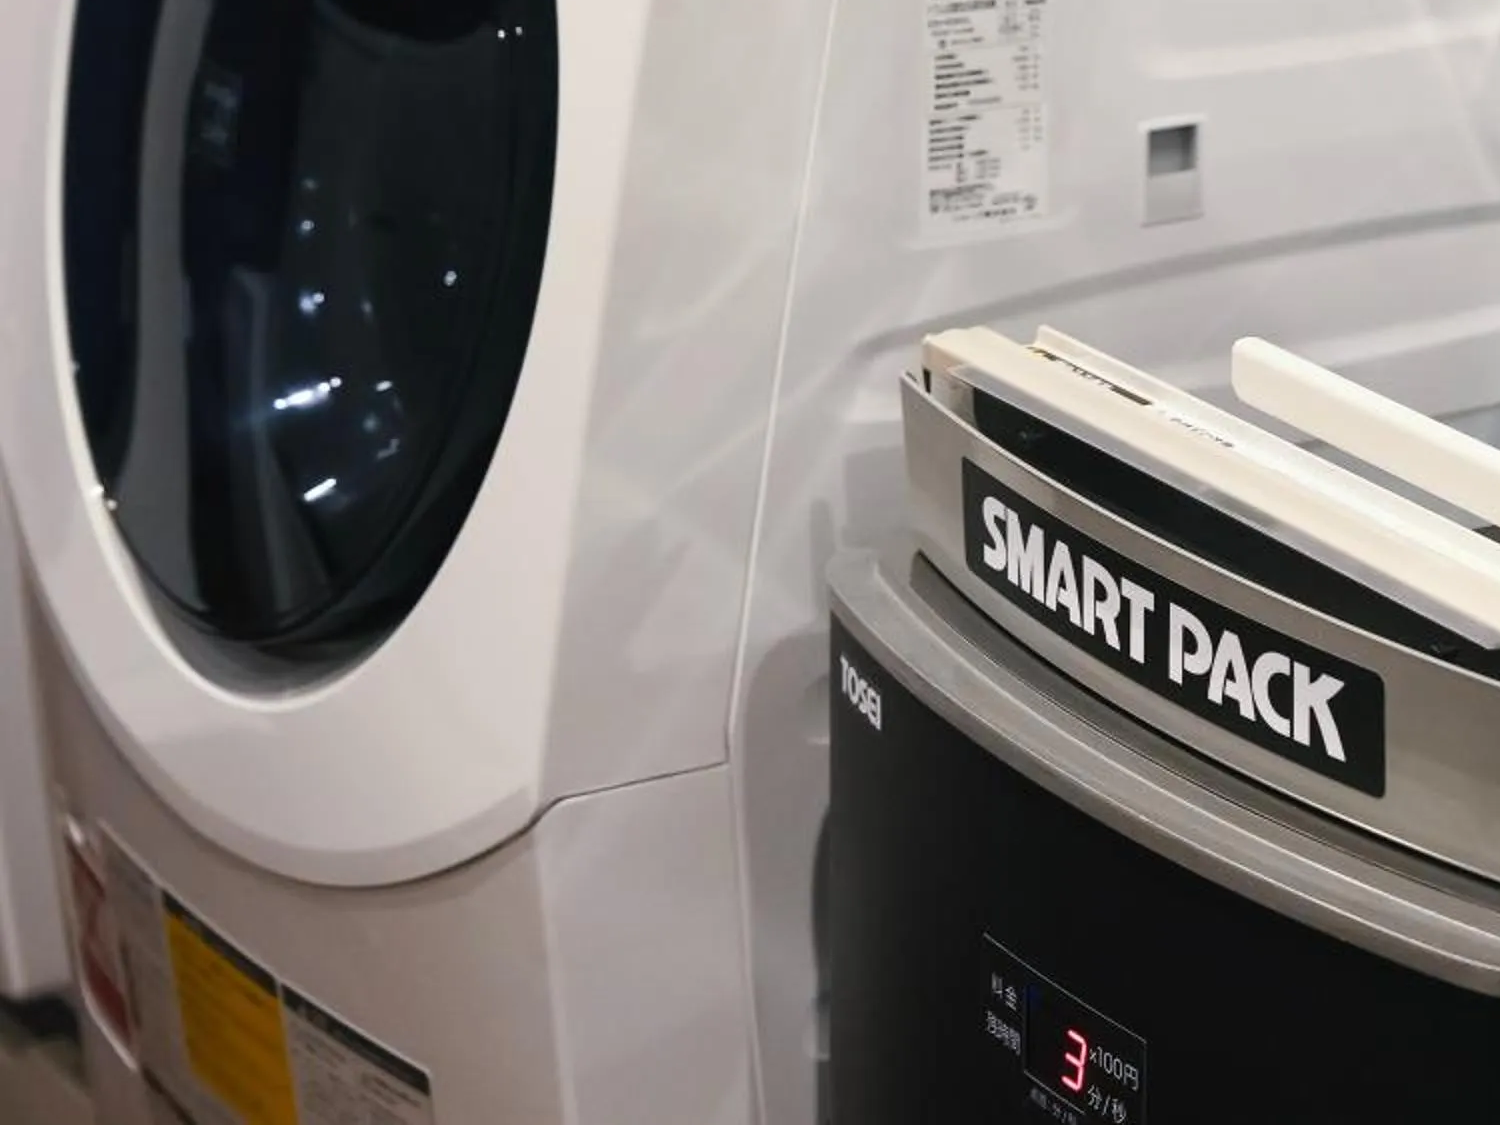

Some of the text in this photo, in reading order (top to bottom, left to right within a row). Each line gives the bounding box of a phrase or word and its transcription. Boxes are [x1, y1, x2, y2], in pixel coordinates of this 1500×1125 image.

[982, 496, 1347, 763] SMART PACK
[840, 655, 882, 731] TOSEI
[1061, 1028, 1088, 1092] 3
